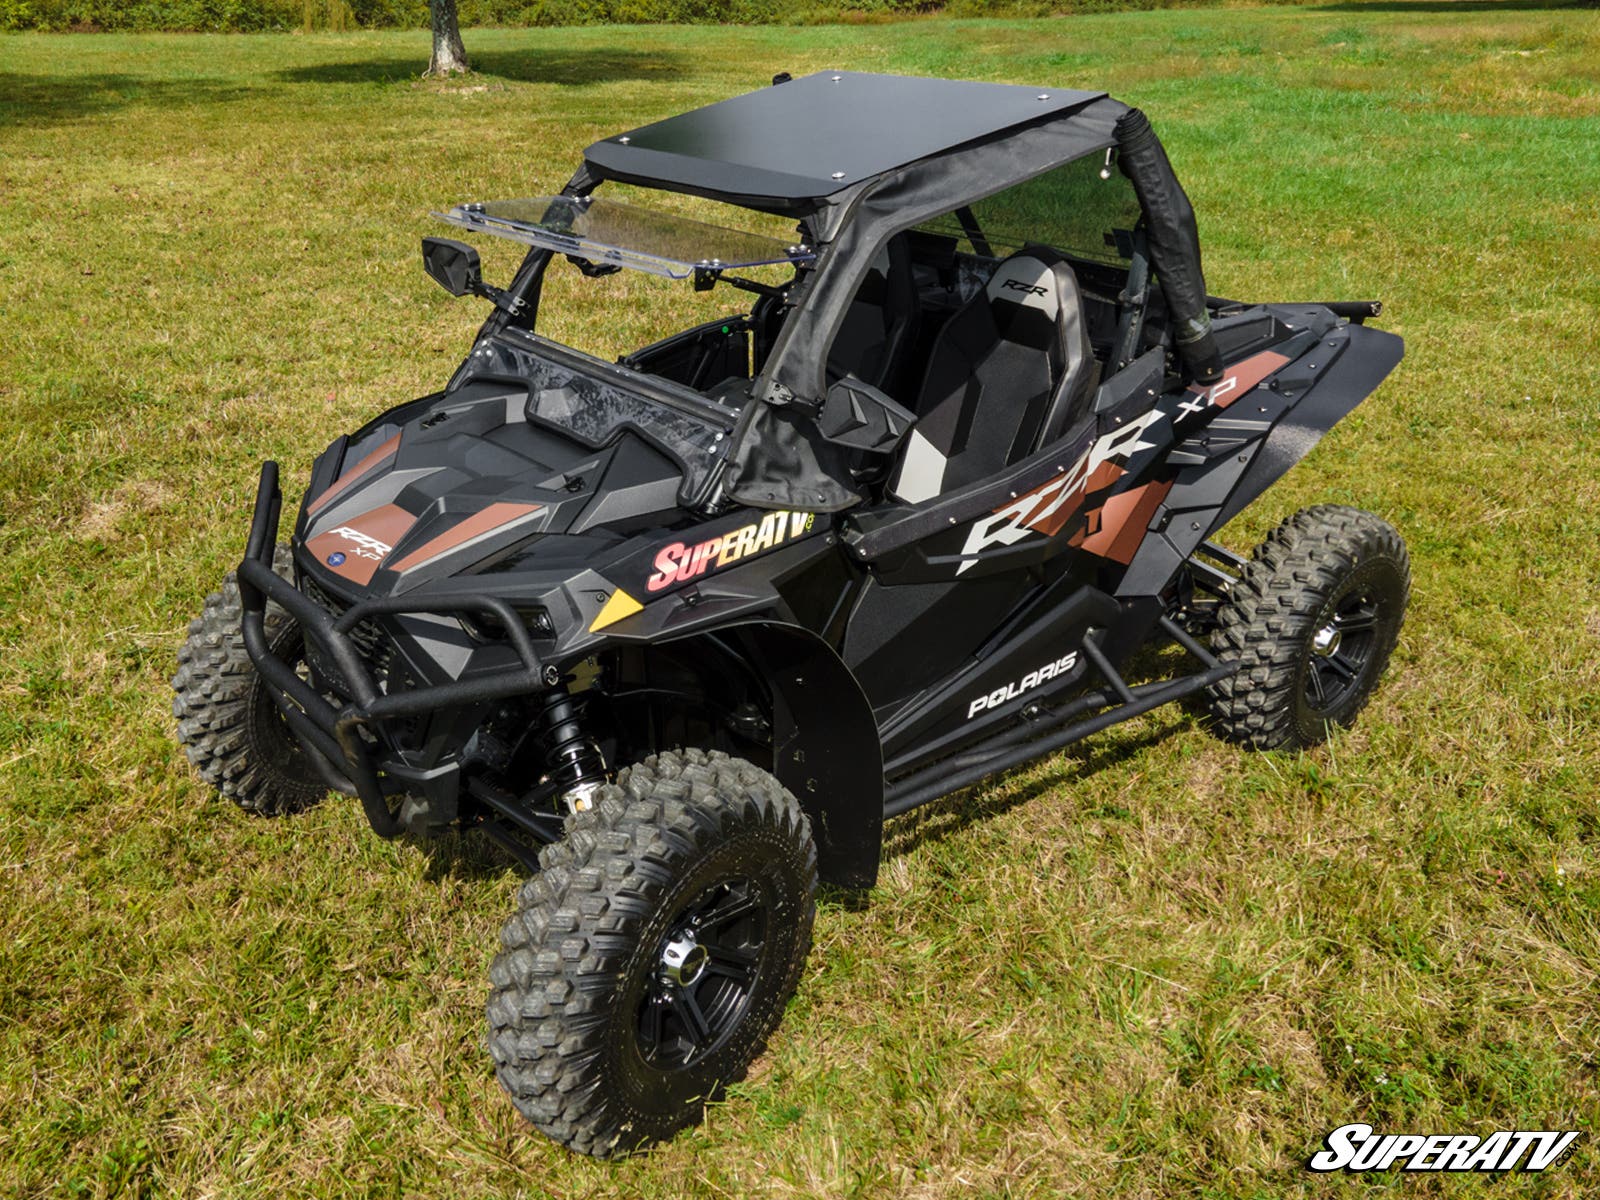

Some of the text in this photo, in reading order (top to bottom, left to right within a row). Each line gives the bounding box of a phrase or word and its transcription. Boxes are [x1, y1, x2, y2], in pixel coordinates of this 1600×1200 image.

[1001, 279, 1048, 297] RZR
[955, 376, 1237, 576] RZR XP
[328, 526, 393, 556] RZR
[349, 547, 382, 560] XP
[646, 510, 809, 592] SUPERATV
[967, 650, 1078, 719] POLARIS
